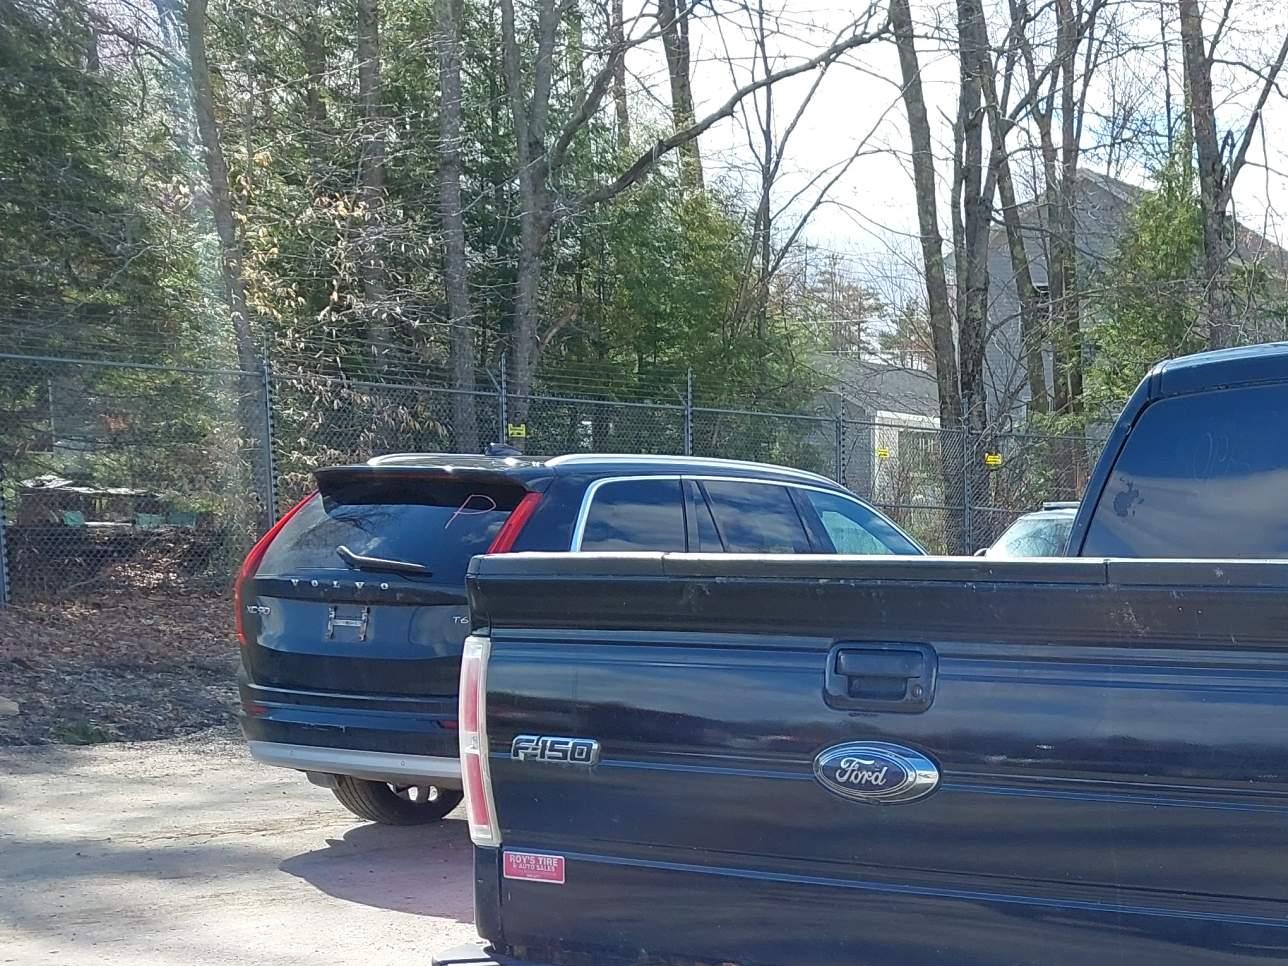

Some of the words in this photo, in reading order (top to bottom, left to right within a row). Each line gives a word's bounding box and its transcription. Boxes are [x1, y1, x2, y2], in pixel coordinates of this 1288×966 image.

[290, 578, 389, 590] VOLVO
[452, 615, 470, 624] T6
[511, 735, 600, 765] F-150
[835, 757, 888, 785] Ford
[509, 854, 535, 865] ROY'S
[537, 857, 559, 868] TIRE
